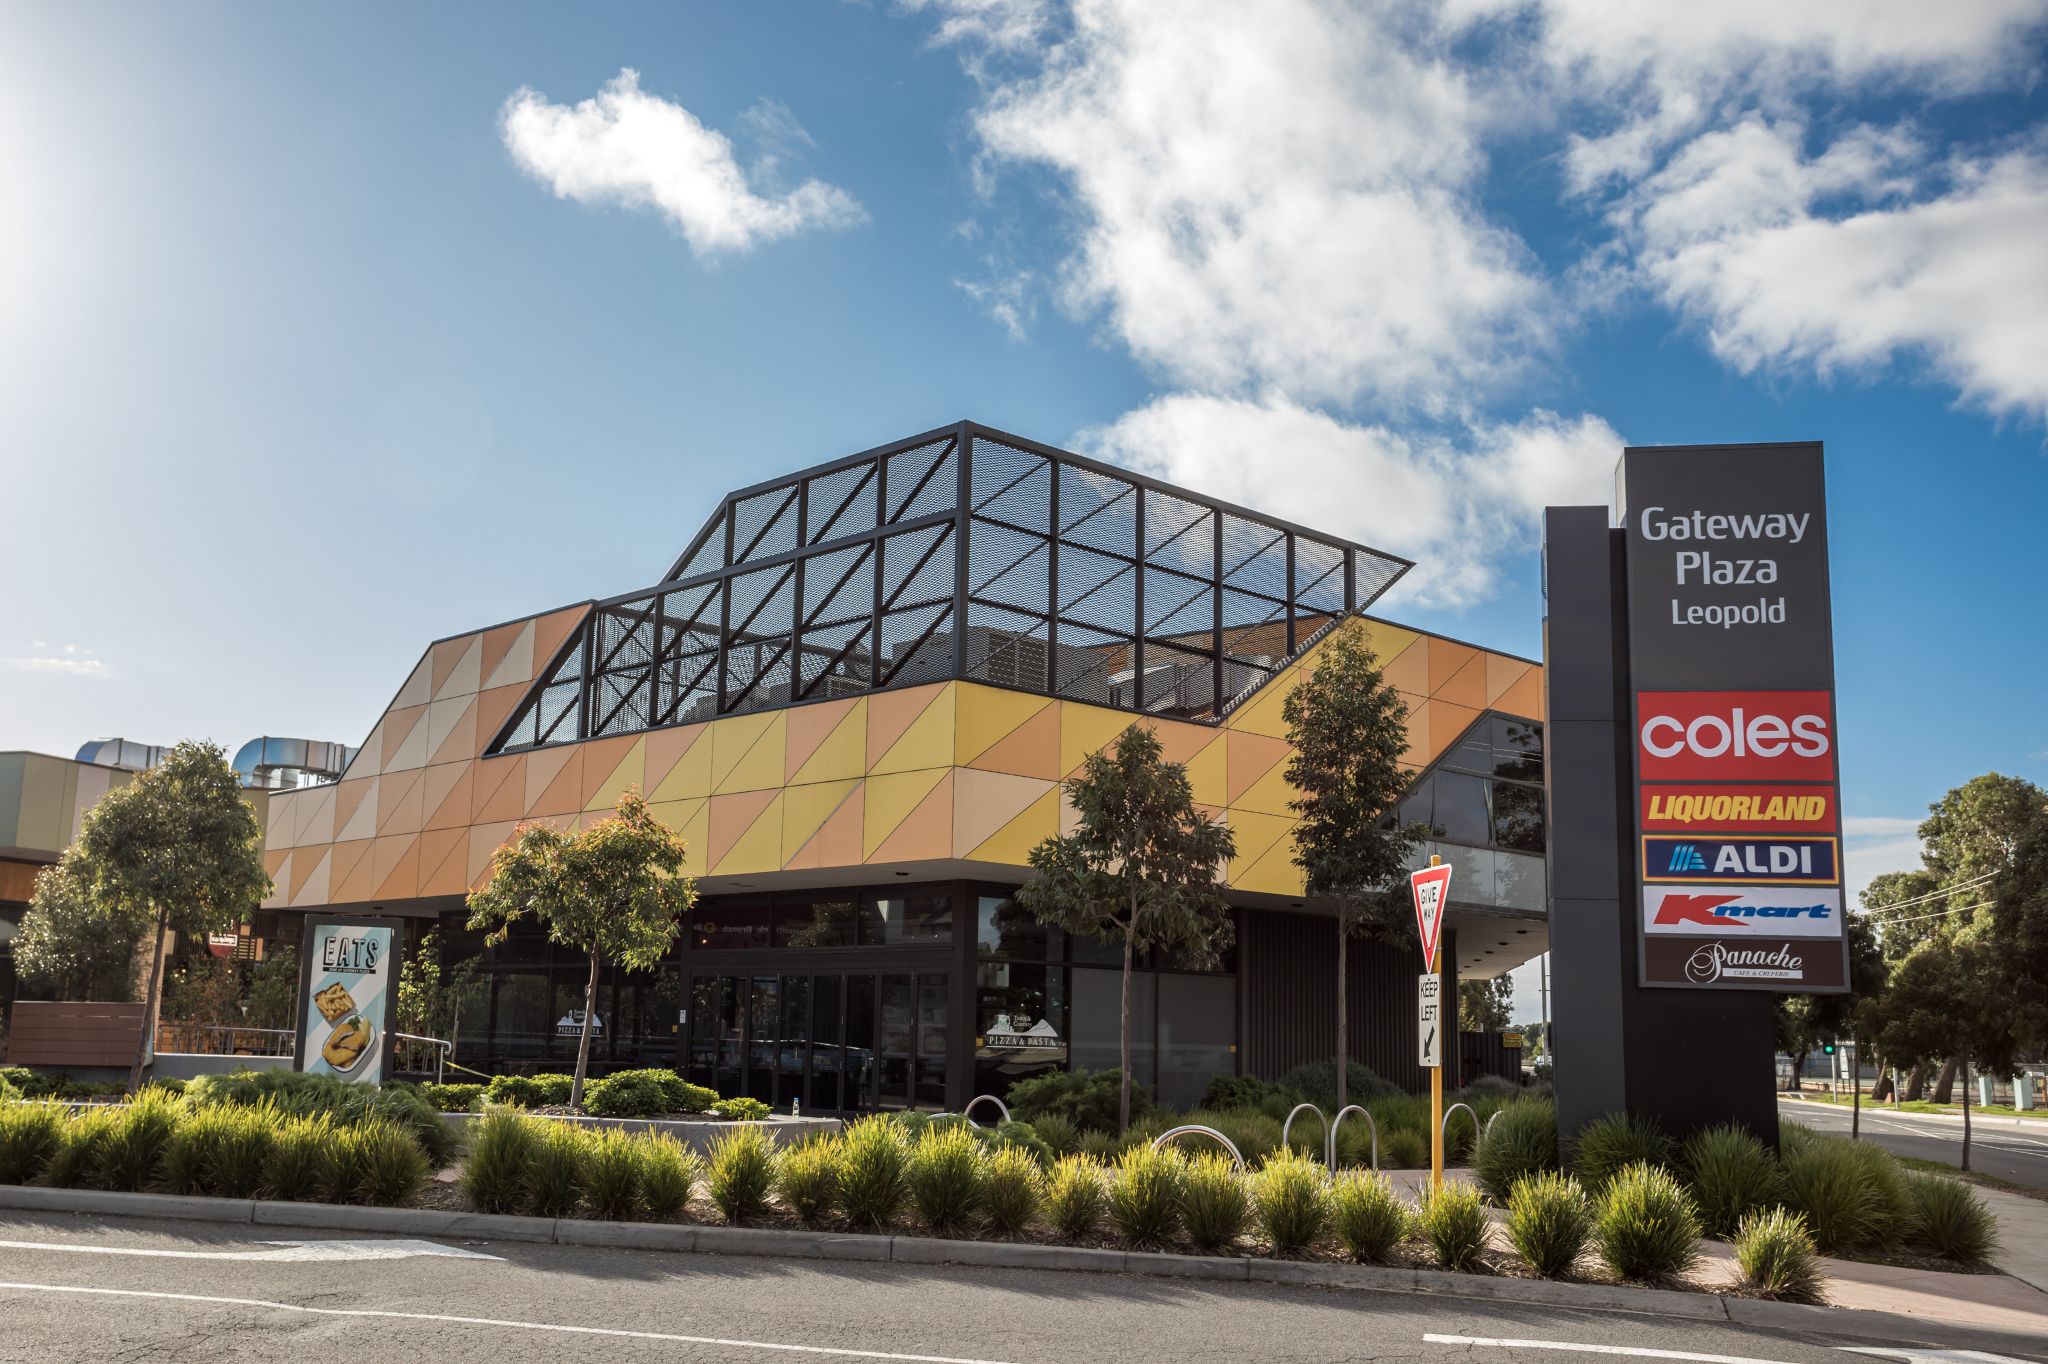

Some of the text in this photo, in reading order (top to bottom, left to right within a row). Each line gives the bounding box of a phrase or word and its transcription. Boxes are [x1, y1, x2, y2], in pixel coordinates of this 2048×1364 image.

[1641, 506, 1810, 543] Gateway
[1676, 551, 1778, 585] Plaza
[1672, 597, 1786, 629] Leopold
[1641, 707, 1829, 758] coles
[1648, 795, 1826, 824] LIQUORLAND
[1713, 845, 1812, 874] ALDI
[1421, 886, 1437, 905] GIVE
[1423, 907, 1435, 921] WAY
[1653, 894, 1832, 927] Kmart
[323, 936, 379, 969] EATS
[1685, 940, 1803, 984] Panache
[1421, 981, 1438, 998] KEEP
[1421, 1005, 1438, 1021] LEFT
[558, 1026, 576, 1034] PIZZA
[989, 1036, 1056, 1046] PIZZA & PASTA
